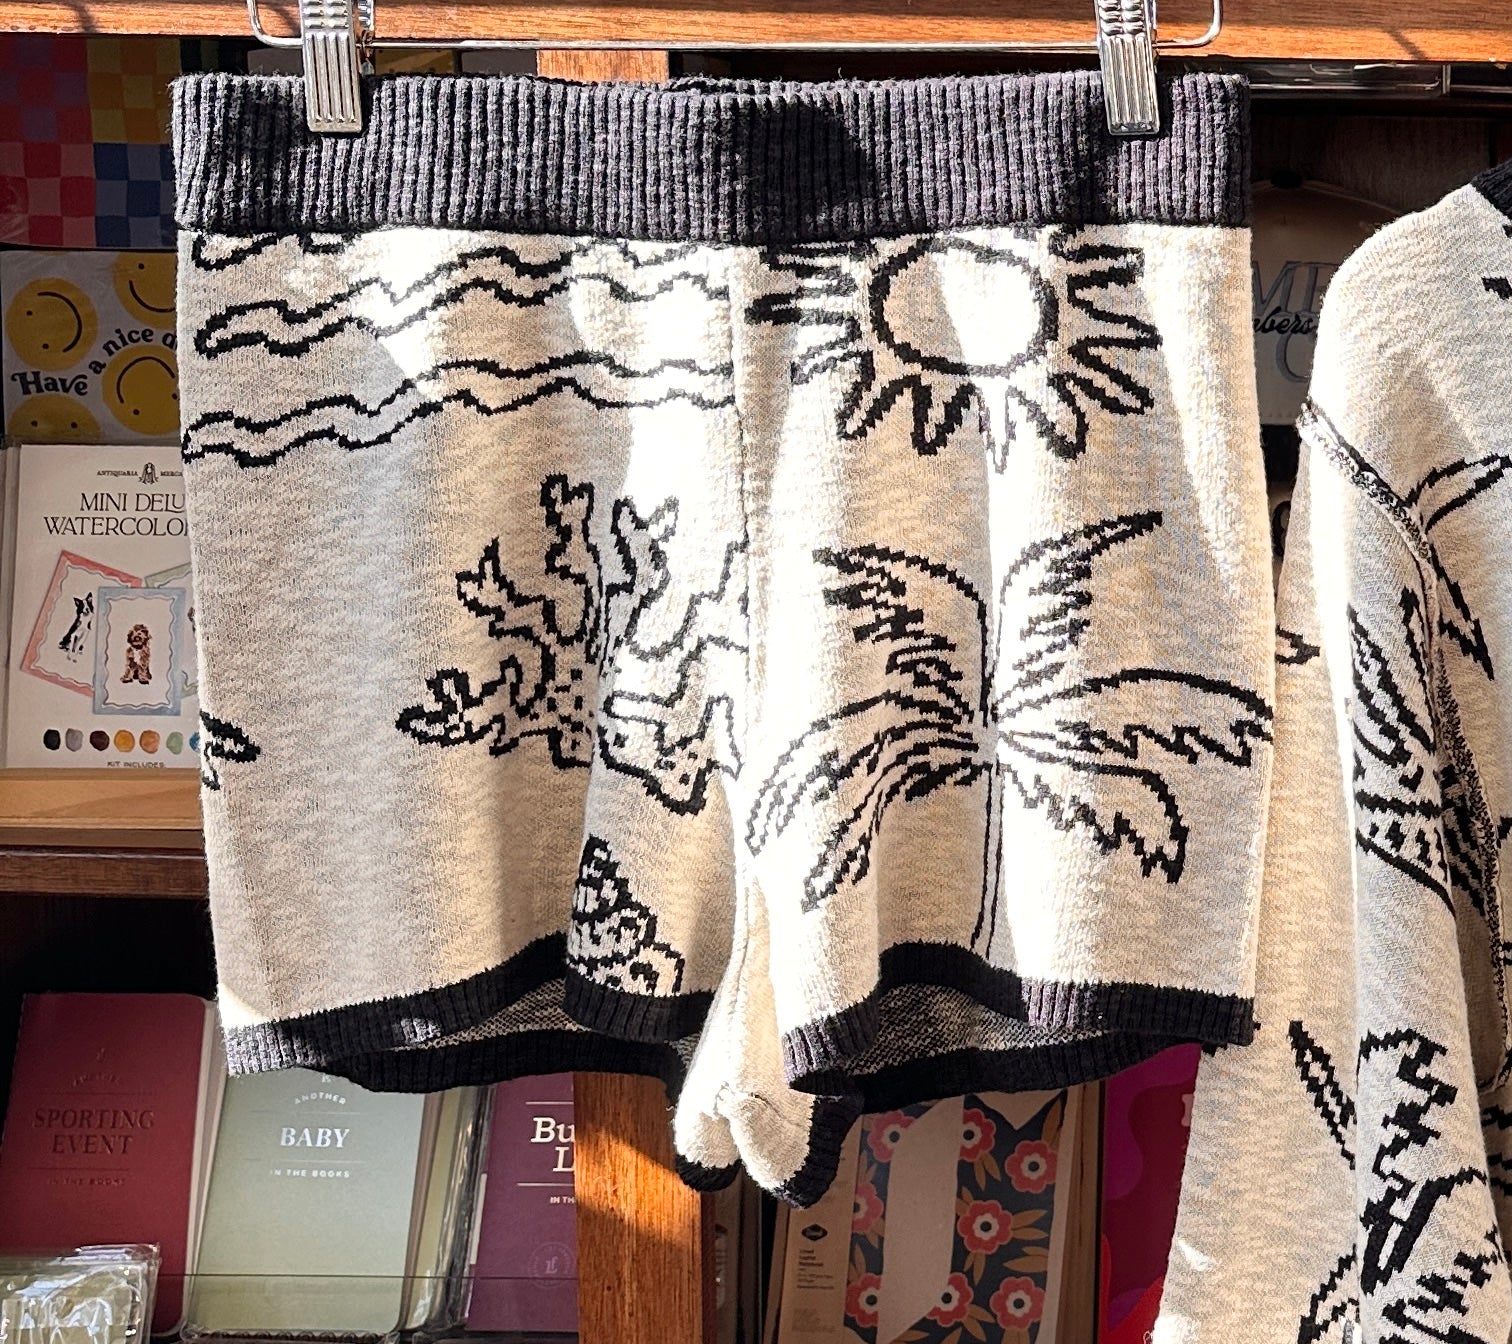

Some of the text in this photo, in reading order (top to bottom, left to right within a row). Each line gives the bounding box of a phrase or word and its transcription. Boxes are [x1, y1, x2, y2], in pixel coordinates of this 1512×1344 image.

[11, 371, 88, 396] Have
[89, 360, 107, 374] a
[102, 328, 154, 356] nice
[80, 492, 128, 512] MINI
[295, 1092, 347, 1105] ANOTHER
[32, 1108, 154, 1130] SPORTING
[52, 1134, 132, 1154] EVENT
[280, 1127, 350, 1148] BABY
[287, 1169, 307, 1177] THE
[312, 1169, 350, 1178] BOOKS
